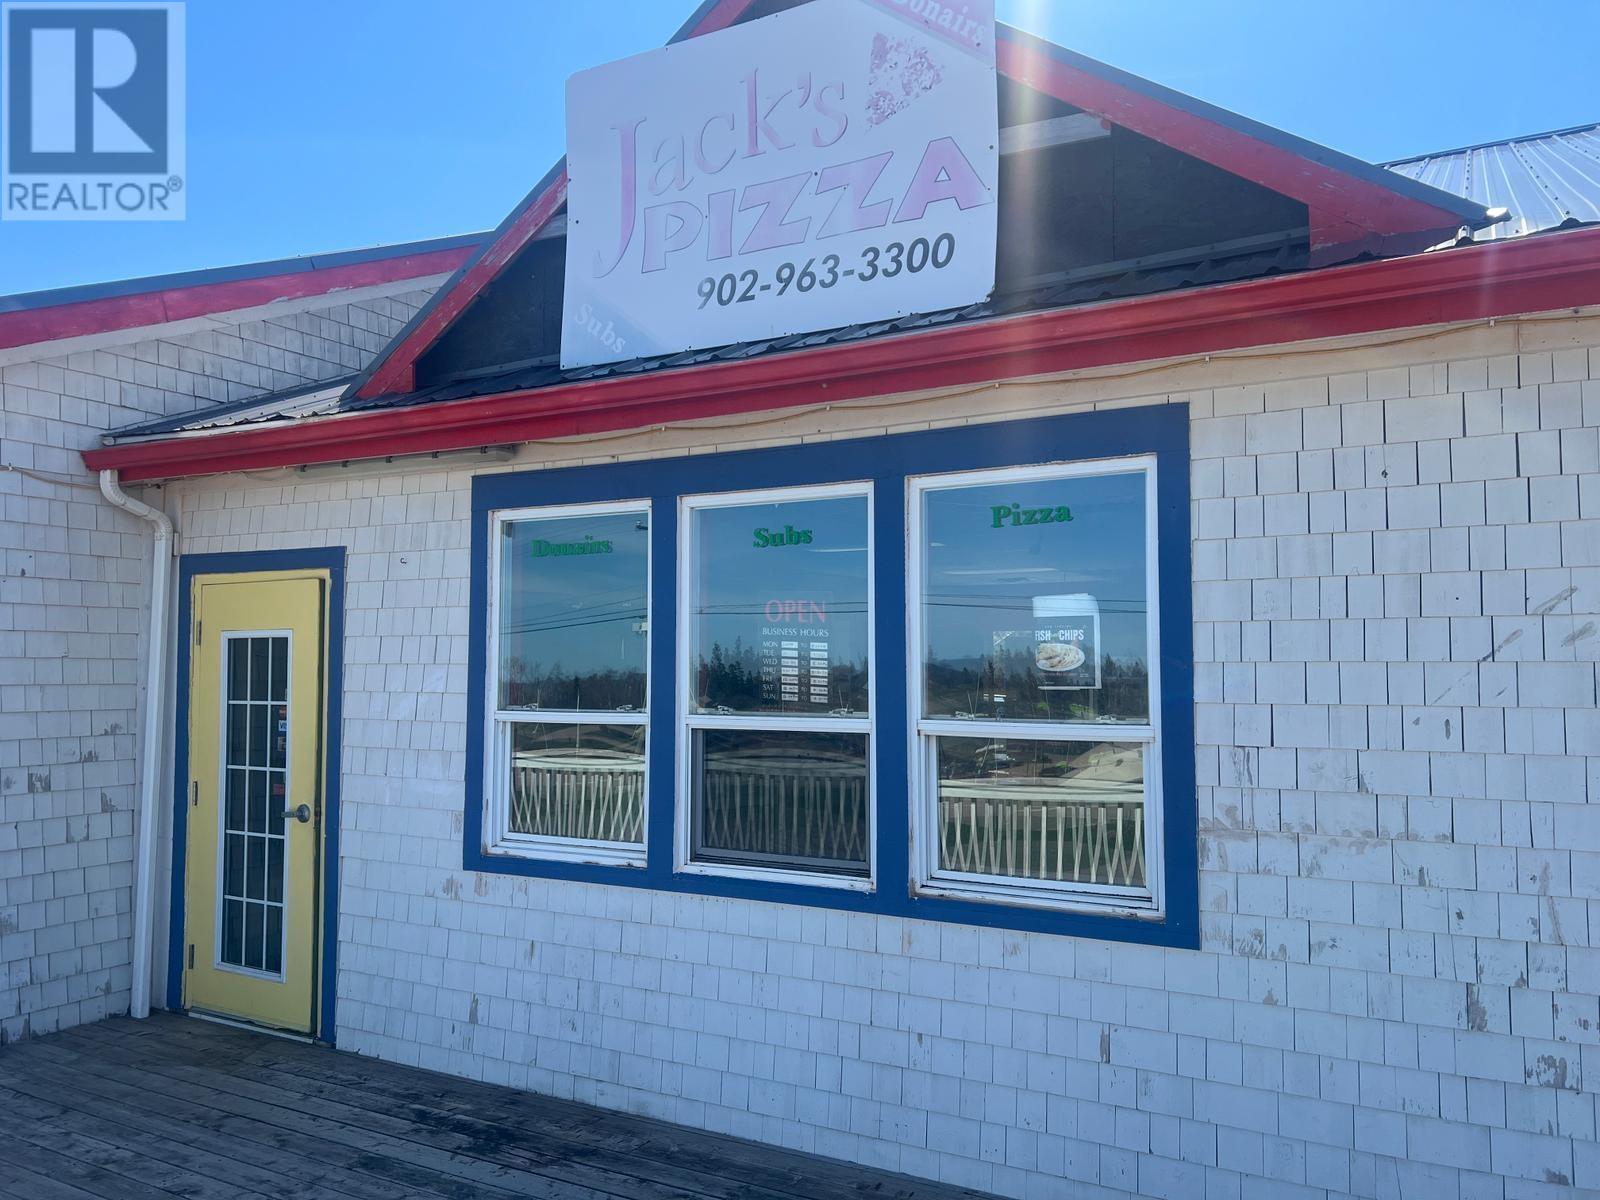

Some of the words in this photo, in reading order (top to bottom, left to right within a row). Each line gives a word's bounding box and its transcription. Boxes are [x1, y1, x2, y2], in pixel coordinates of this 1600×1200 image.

[592, 66, 849, 279] Jack's
[641, 136, 996, 275] PIZZA
[697, 232, 956, 310] 902-963-3300
[574, 303, 626, 353] Subs
[990, 502, 1074, 528] Pizza
[753, 525, 814, 549] Subs
[764, 599, 827, 623] OPEN
[762, 628, 797, 636] BUSINESS
[800, 629, 829, 637] HOURS
[1060, 629, 1085, 641] CHIPS
